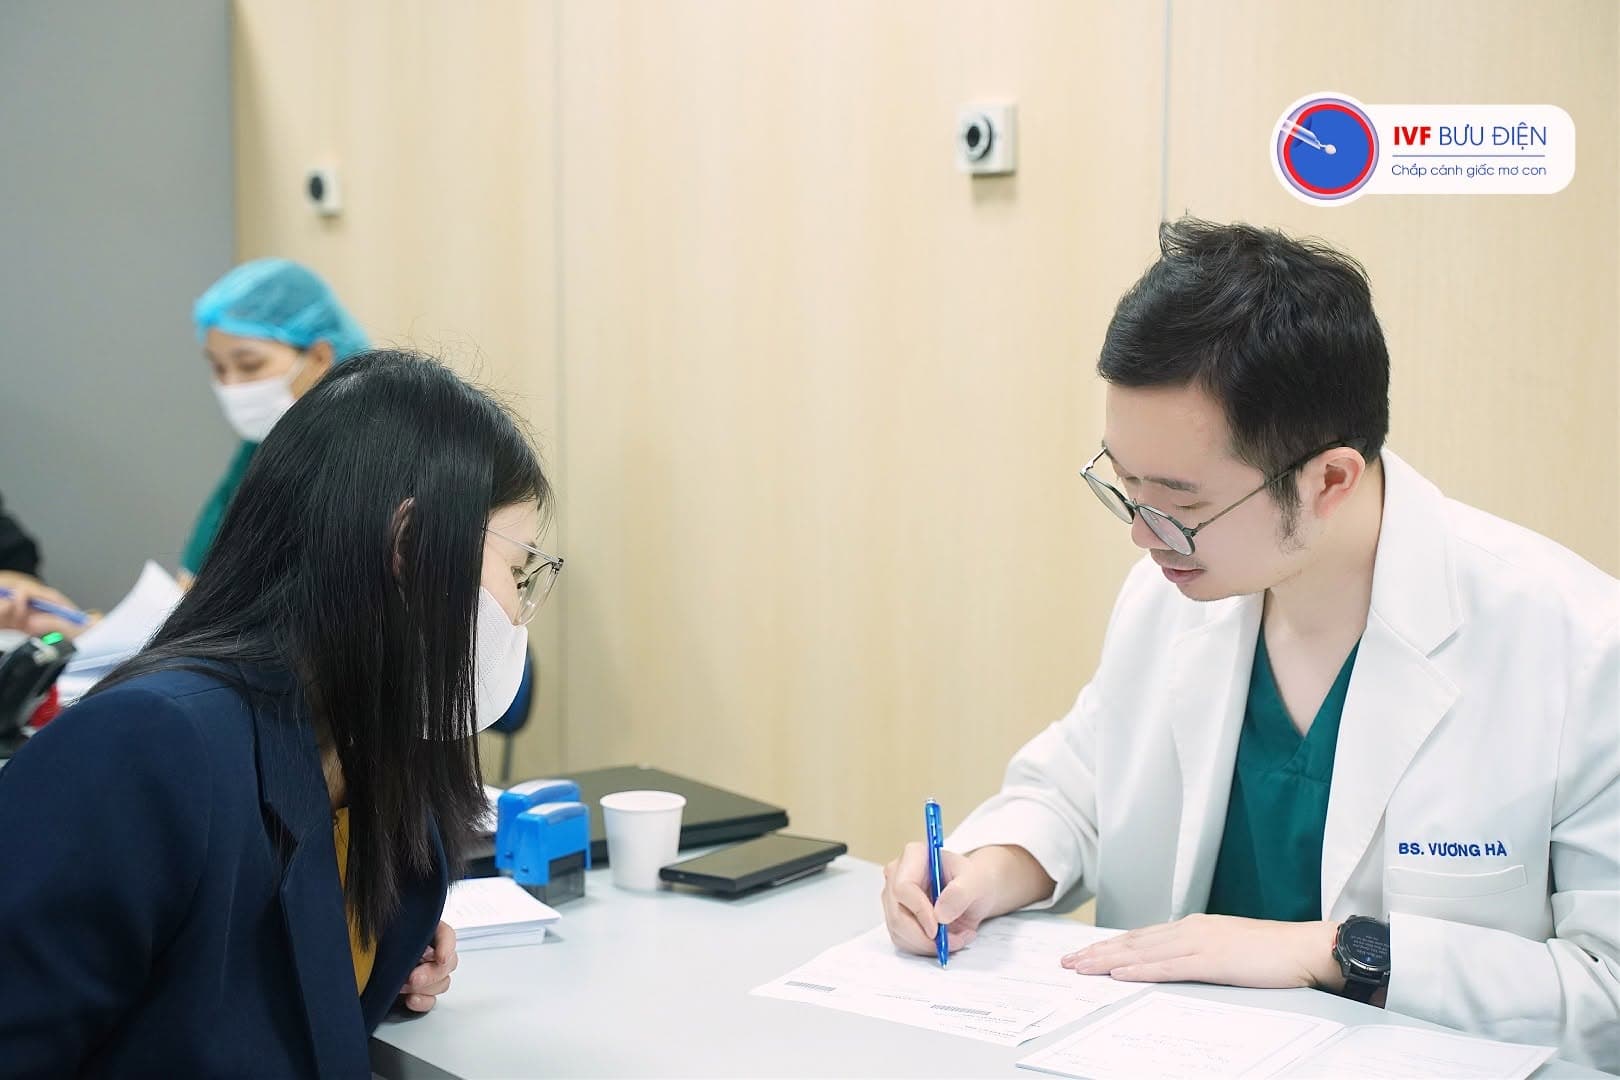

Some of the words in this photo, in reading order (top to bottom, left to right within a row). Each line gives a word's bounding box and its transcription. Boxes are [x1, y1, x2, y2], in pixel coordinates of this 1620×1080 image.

[1398, 842, 1425, 856] BS.
[1428, 842, 1481, 857] VƯƠNG
[1485, 840, 1508, 857] HÀ
